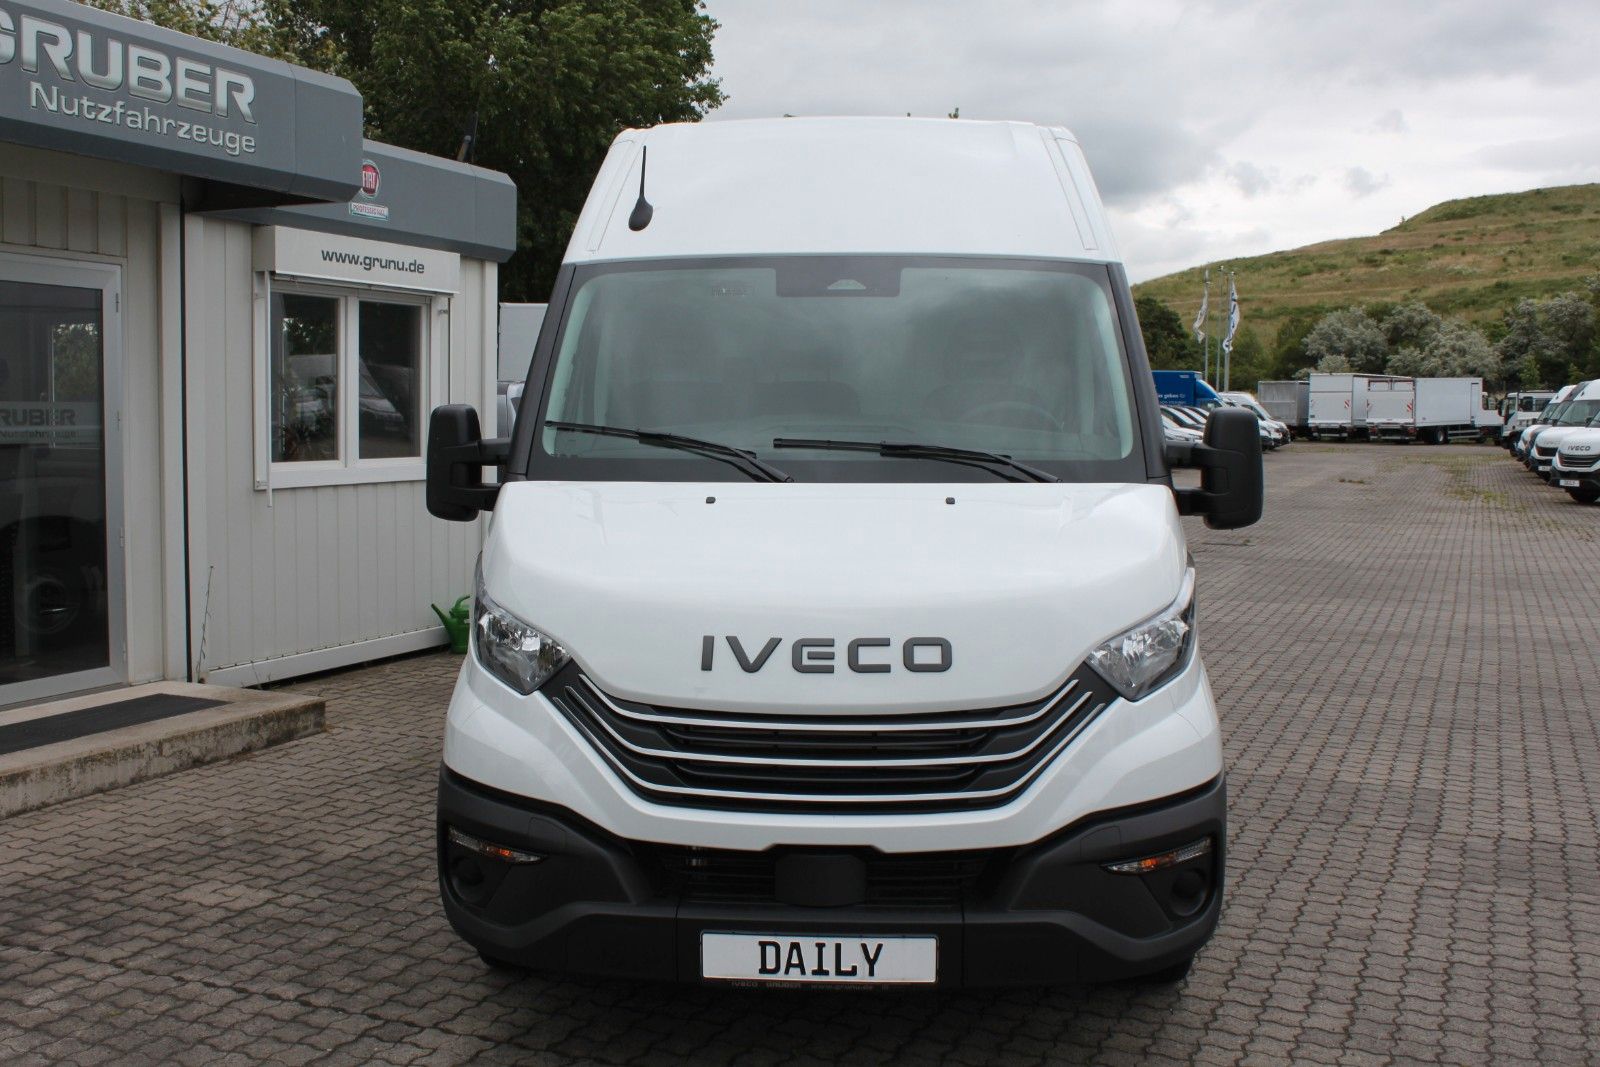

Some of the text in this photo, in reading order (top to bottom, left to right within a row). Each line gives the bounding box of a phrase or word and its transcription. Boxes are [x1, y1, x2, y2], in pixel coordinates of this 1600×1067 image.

[0, 8, 257, 125] RUBER
[30, 81, 256, 156] Nutzfahrzeuge
[321, 249, 425, 274] www.grunu.de
[701, 635, 953, 674] IVECO
[758, 940, 884, 976] DAILY
